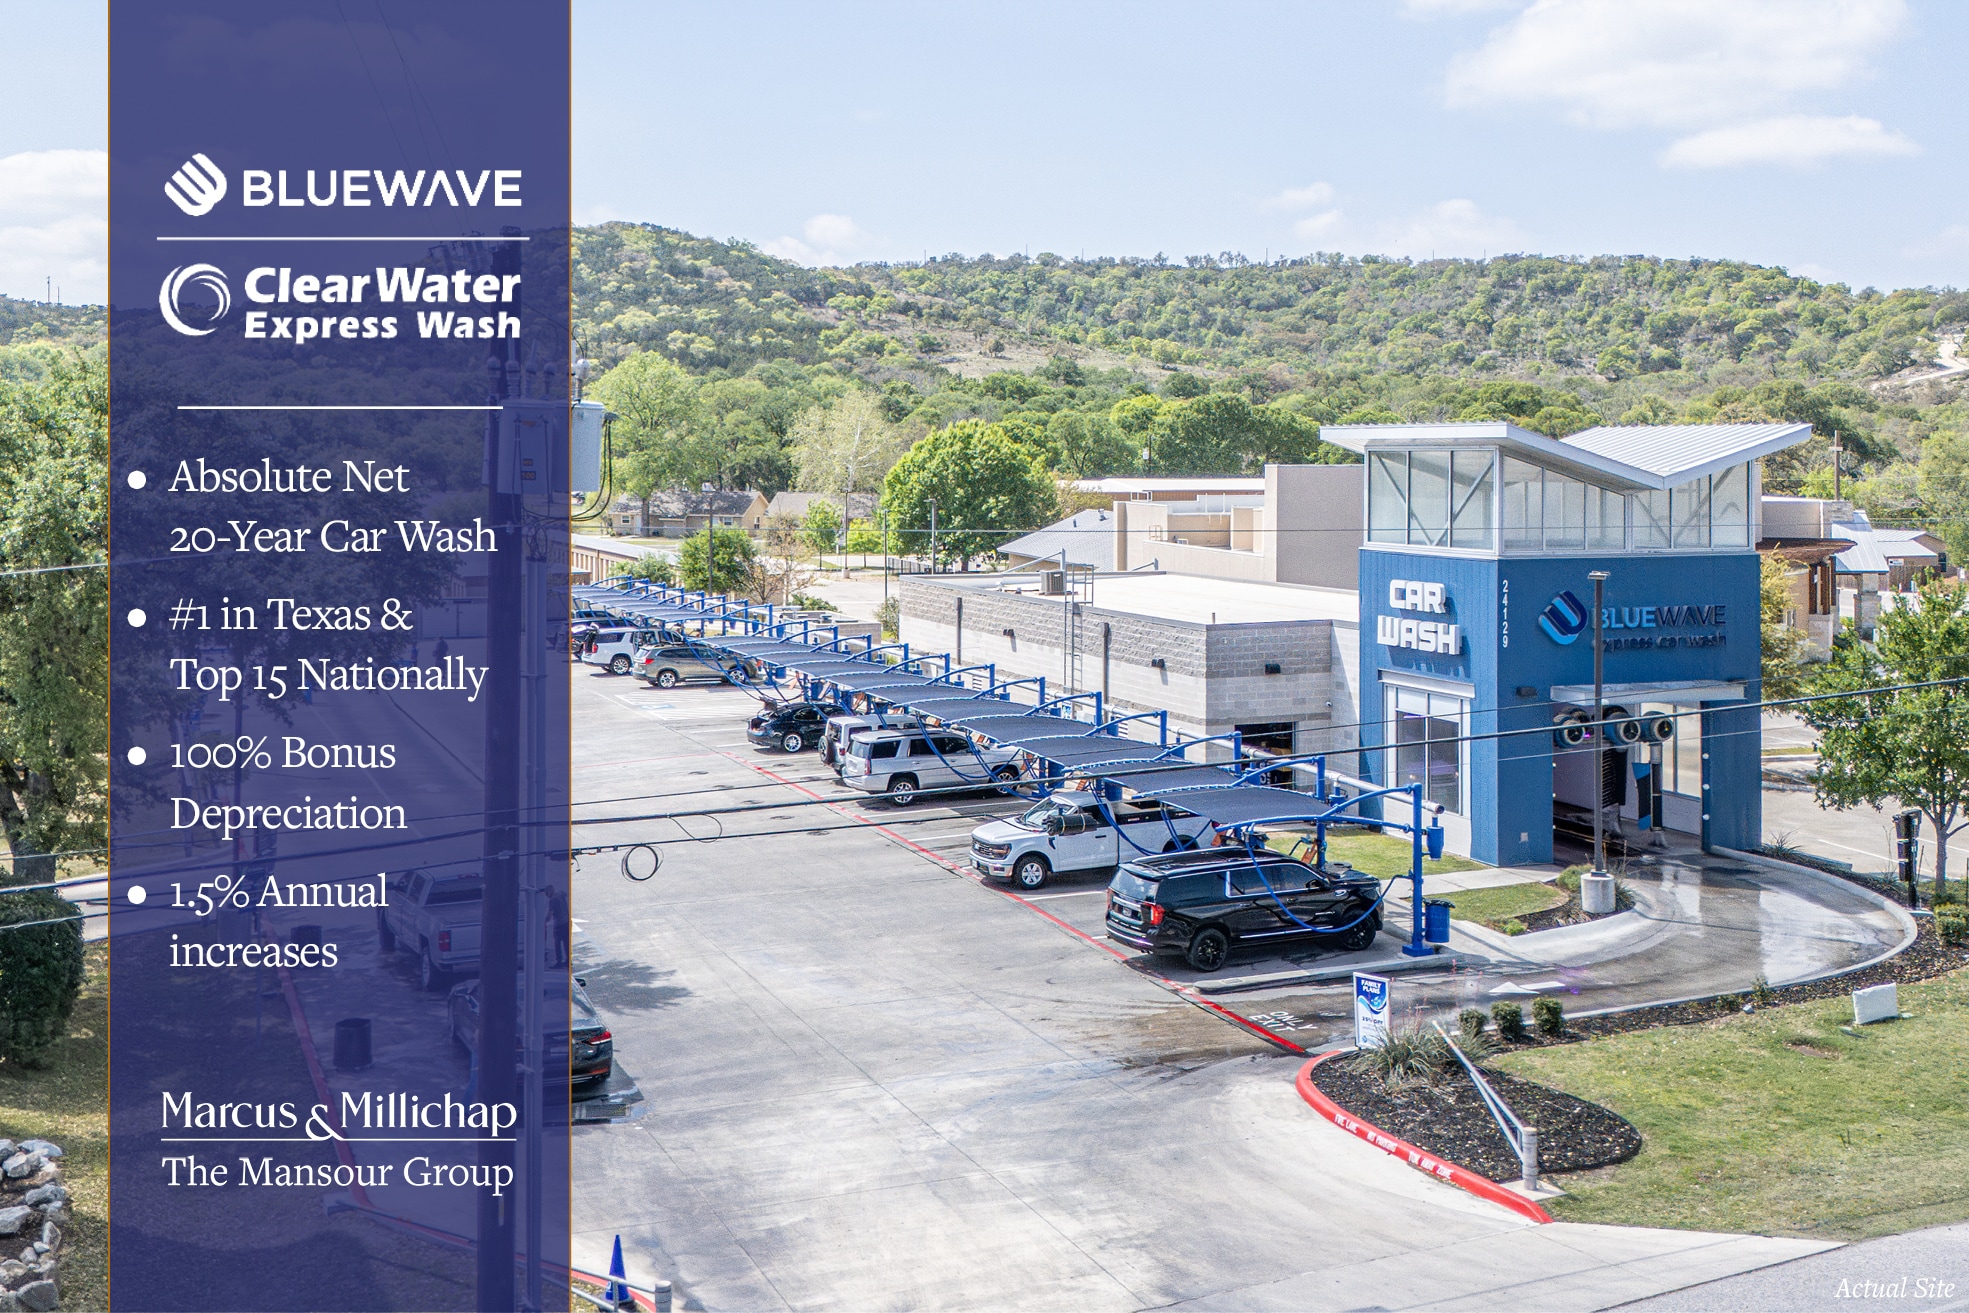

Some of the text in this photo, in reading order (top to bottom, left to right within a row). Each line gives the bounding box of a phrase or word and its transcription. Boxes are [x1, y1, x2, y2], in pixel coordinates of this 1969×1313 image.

[1389, 579, 1446, 614] CAR
[1377, 614, 1461, 656] WASH
[1592, 634, 1653, 652] xpress
